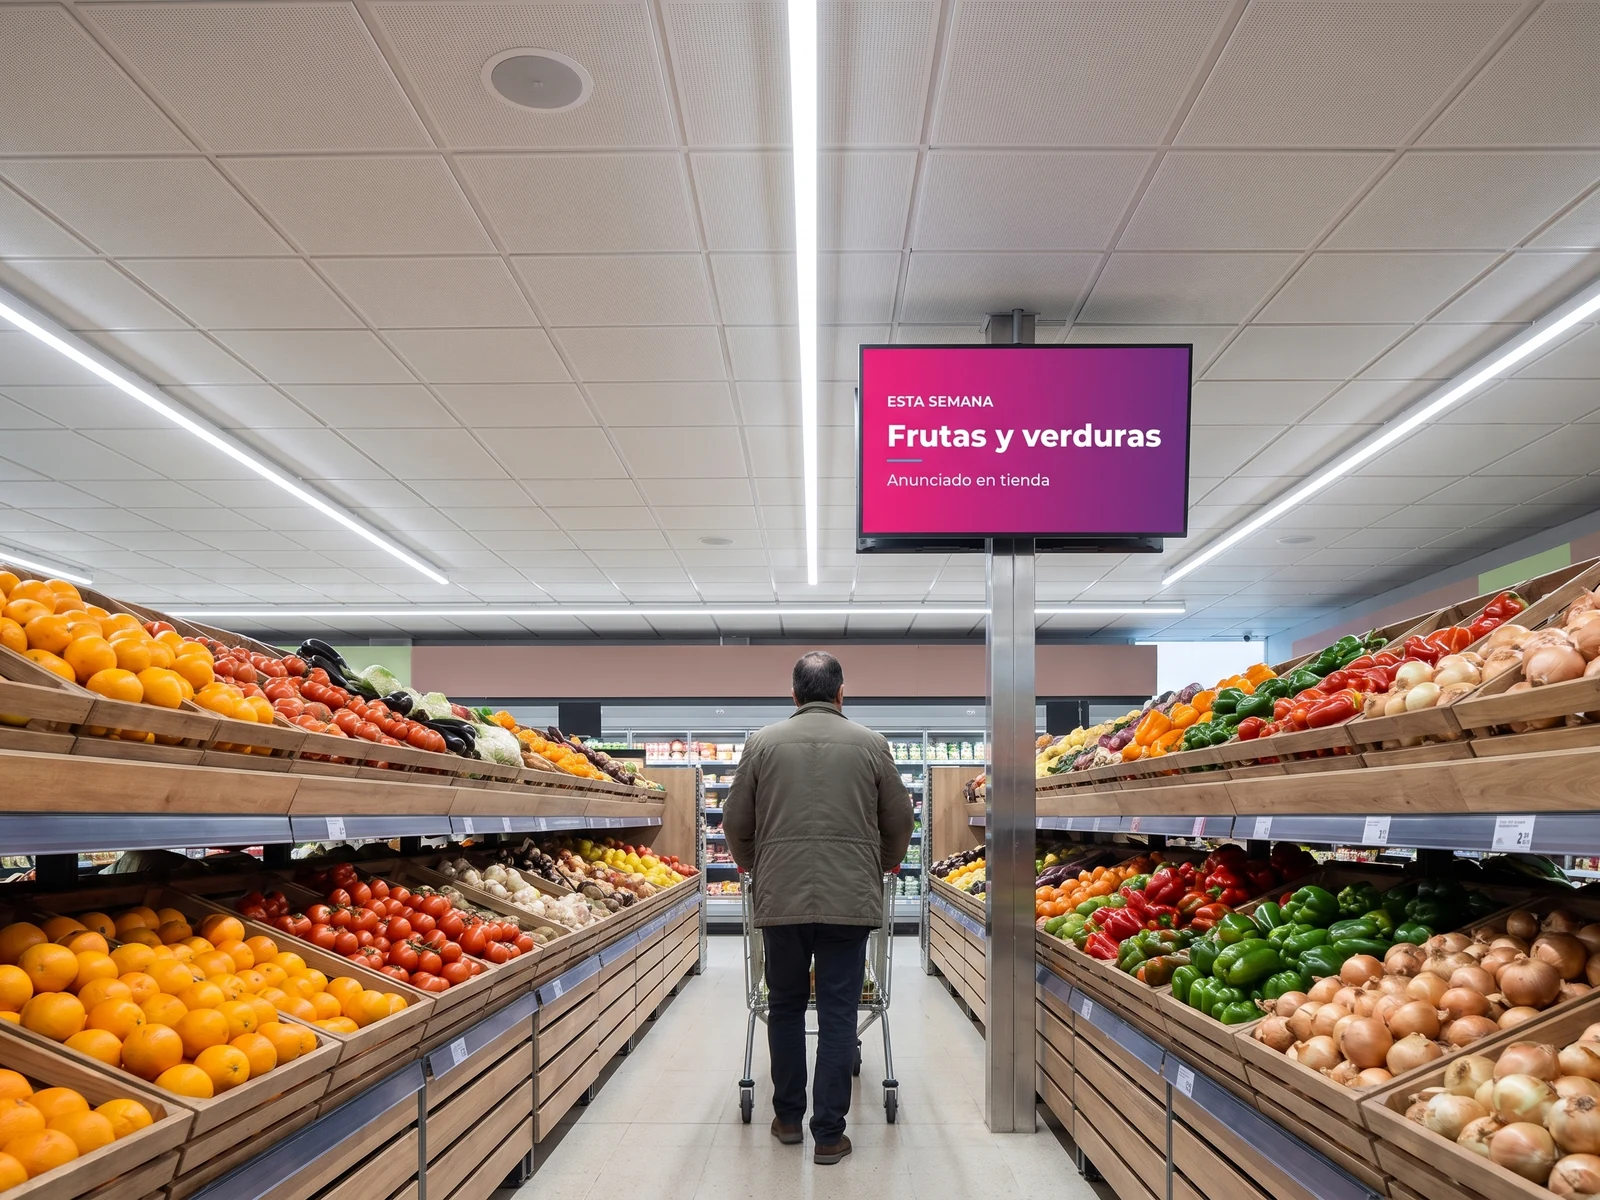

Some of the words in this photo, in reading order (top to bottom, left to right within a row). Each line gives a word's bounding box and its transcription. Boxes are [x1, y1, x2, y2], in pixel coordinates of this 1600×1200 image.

[887, 395, 925, 408] ESTA
[928, 395, 994, 408] SEMANA
[887, 424, 987, 448] Frutas
[994, 429, 1015, 454] y
[1021, 423, 1162, 448] verduras
[886, 473, 972, 487] Anunciado
[976, 476, 996, 487] en
[999, 473, 1050, 487] tienda
